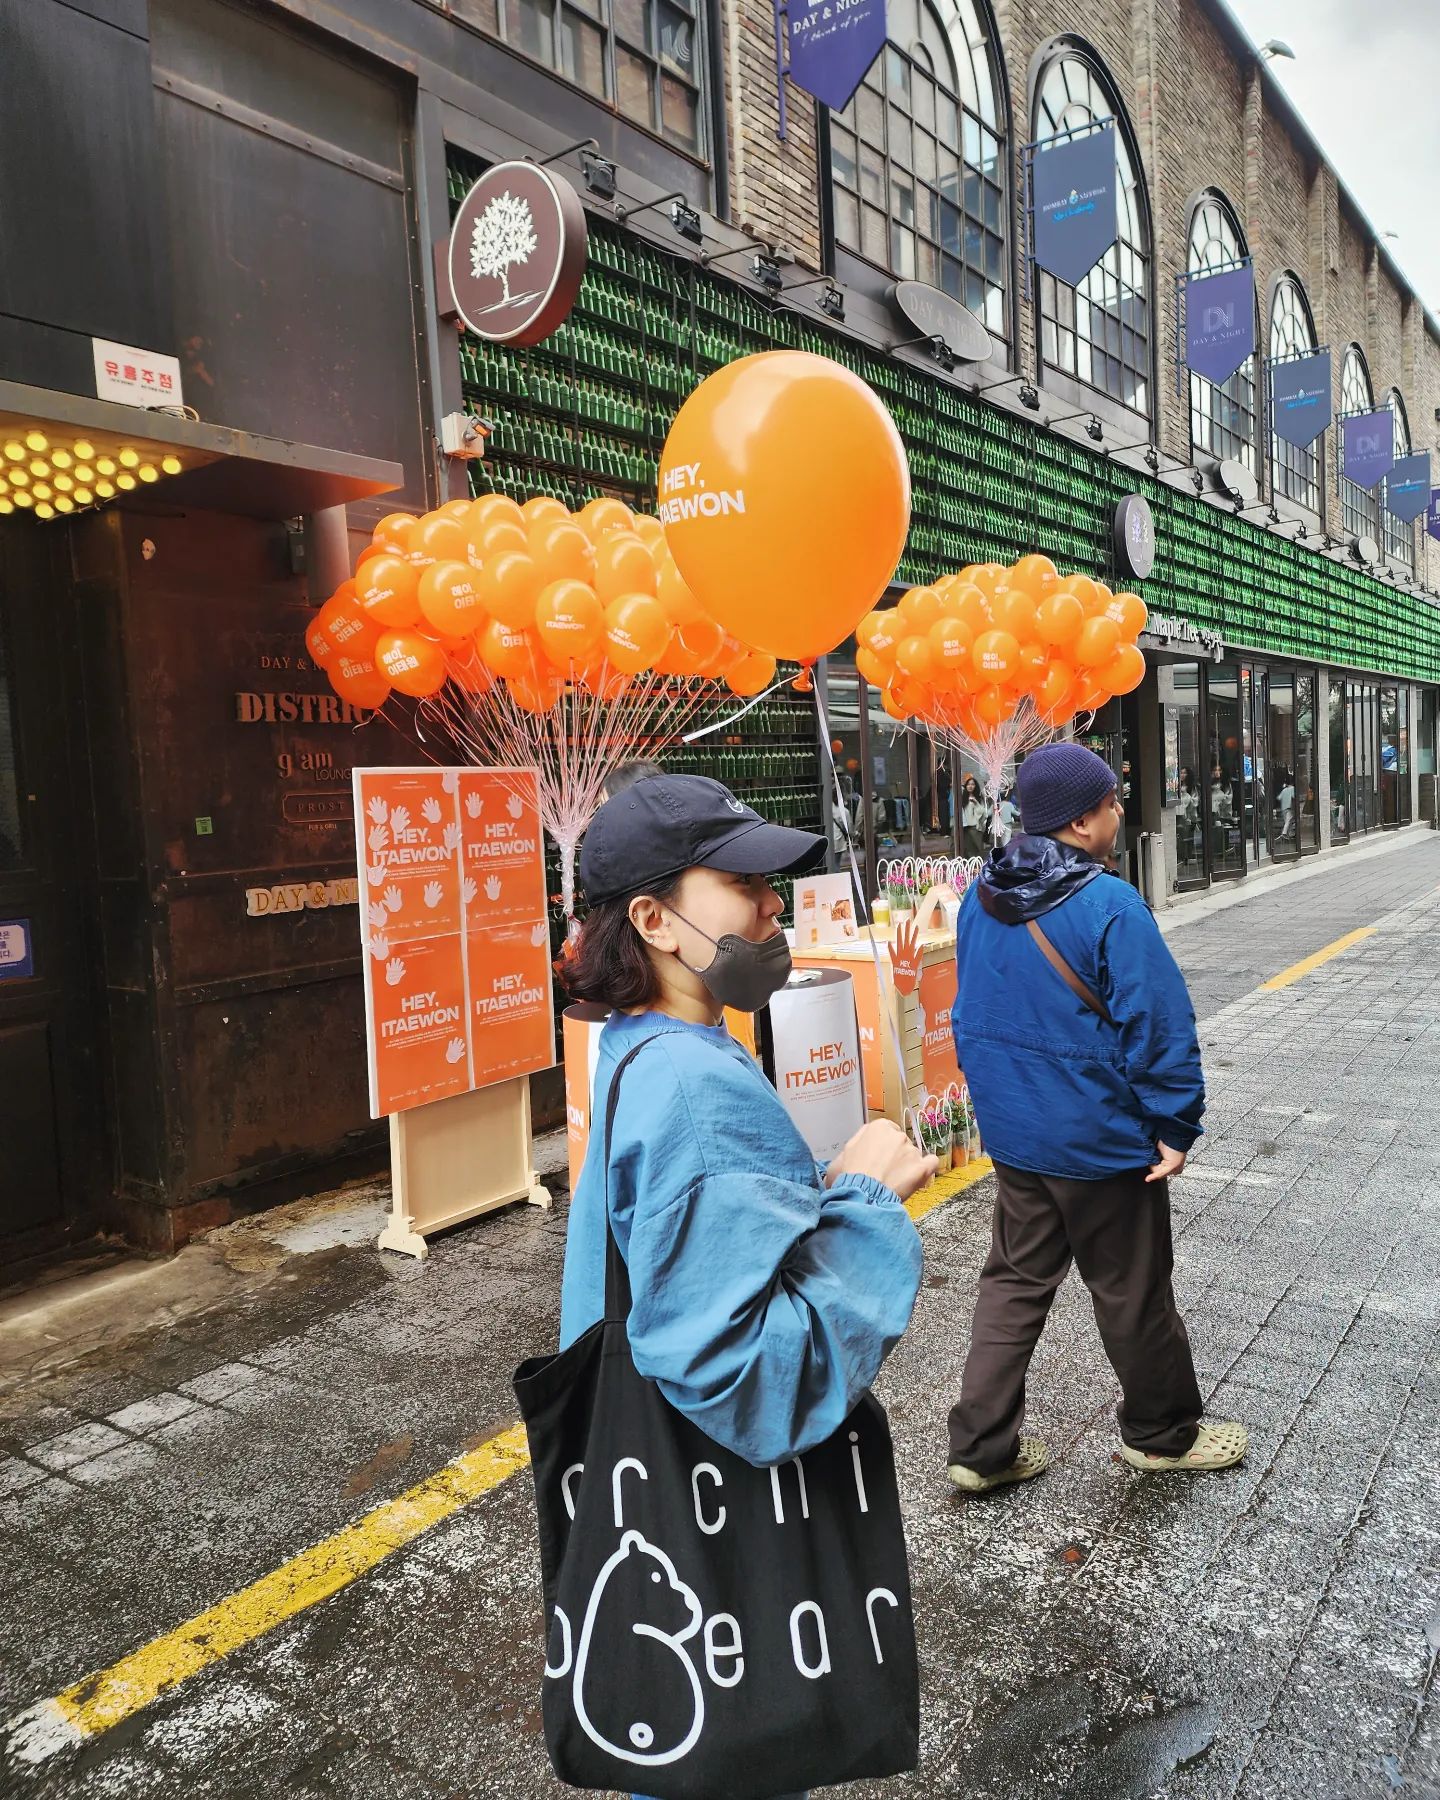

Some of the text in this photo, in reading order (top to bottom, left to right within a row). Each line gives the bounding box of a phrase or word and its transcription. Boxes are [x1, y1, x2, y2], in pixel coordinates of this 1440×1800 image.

[793, 12, 818, 34] DAY
[822, 7, 832, 20] &
[663, 462, 705, 495] HEY,
[660, 489, 746, 527] TAEWON
[1150, 611, 1181, 645] Maple
[261, 656, 290, 669] DAY
[297, 658, 306, 670] &
[387, 655, 420, 677] 이태원
[236, 692, 386, 723] DISTRIC
[315, 769, 352, 781] LOUNG
[298, 801, 345, 813] PROST
[393, 827, 431, 844] HEY,
[485, 822, 518, 838] HEY,
[372, 846, 452, 867] ITAEWON
[468, 839, 535, 859] ITAEWON
[255, 888, 303, 912] DAY
[313, 886, 326, 904] &
[493, 973, 526, 992] HEY,
[893, 967, 916, 978] ITAEWON
[401, 991, 439, 1013] HEY,
[475, 987, 544, 1015] ITAEWON
[381, 1005, 460, 1038] ITAEWON
[925, 1026, 953, 1047] ITAEW
[809, 1041, 846, 1064] HEY,
[785, 1056, 857, 1089] ITAEWON
